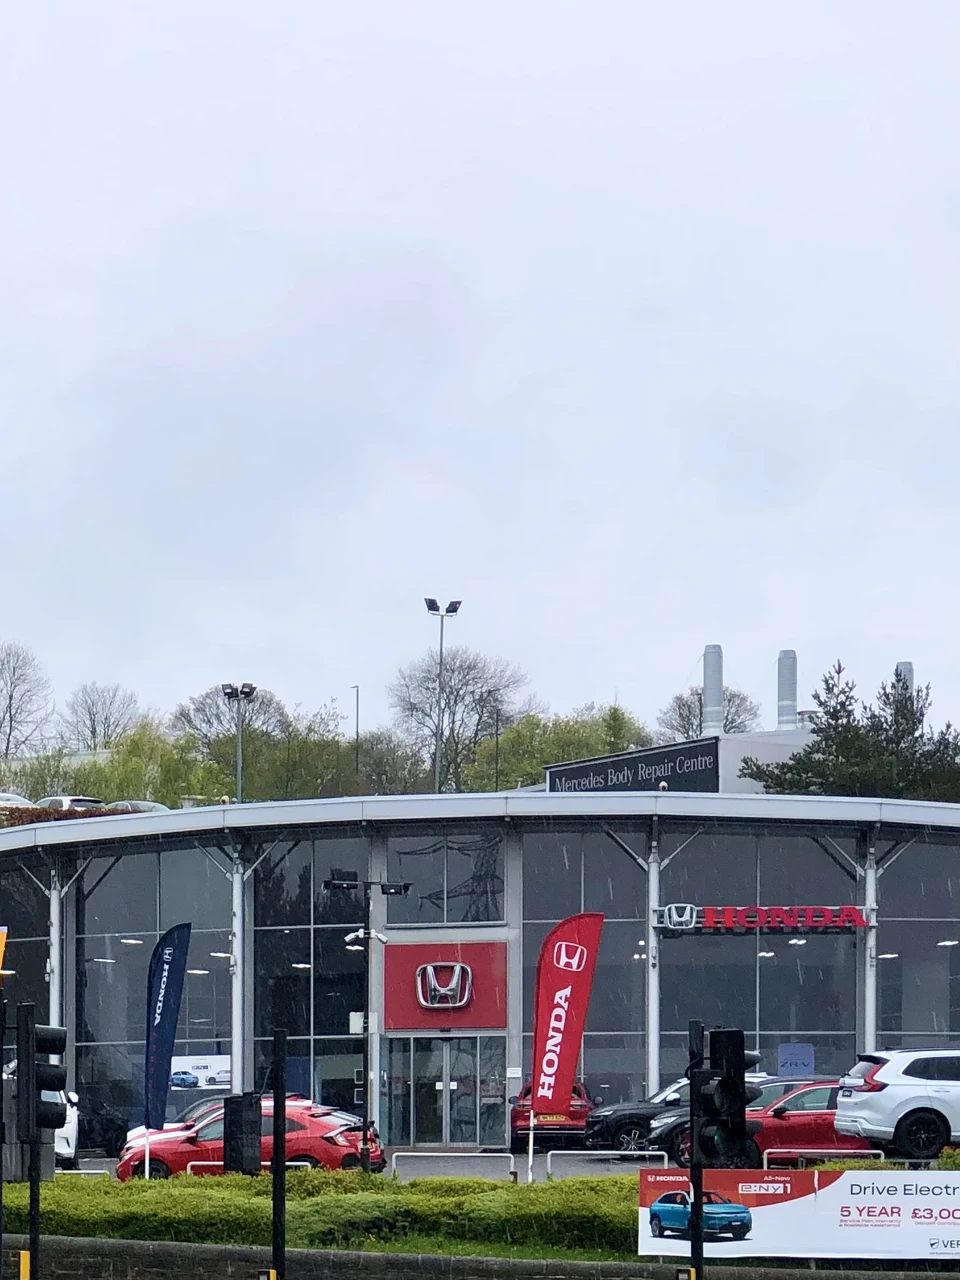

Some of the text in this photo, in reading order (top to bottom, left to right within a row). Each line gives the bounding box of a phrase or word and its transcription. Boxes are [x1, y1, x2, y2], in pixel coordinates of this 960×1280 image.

[555, 754, 714, 792] Mercedes Body Repair Centre
[702, 906, 868, 927] HONDA
[153, 963, 170, 1026] HONDA
[537, 985, 572, 1100] HONDA
[850, 1182, 898, 1196] Drive
[840, 1206, 901, 1217] 5 YEAR
